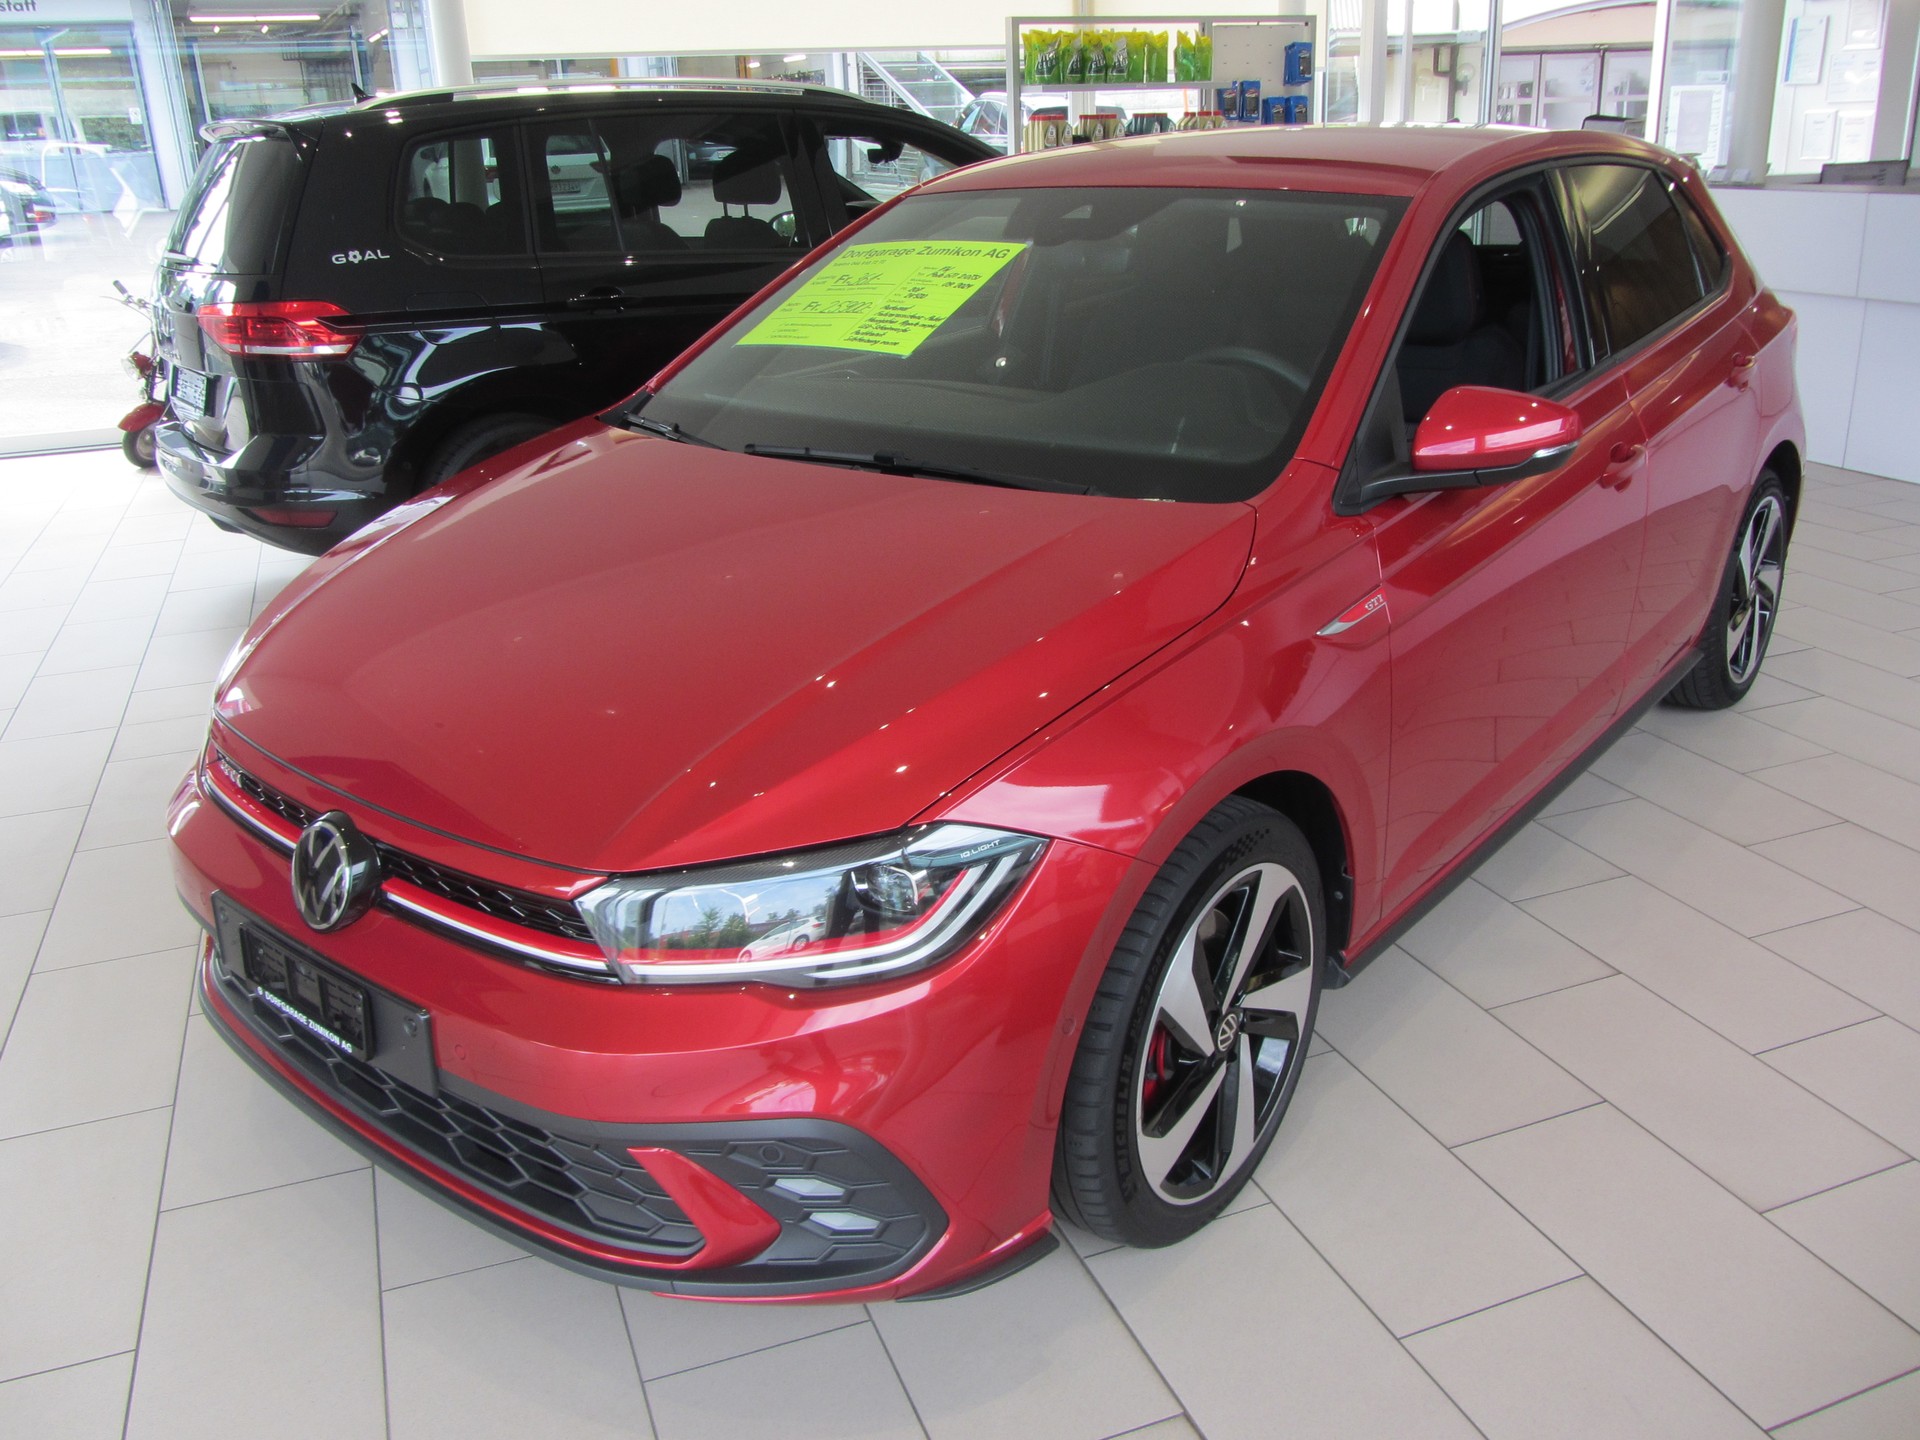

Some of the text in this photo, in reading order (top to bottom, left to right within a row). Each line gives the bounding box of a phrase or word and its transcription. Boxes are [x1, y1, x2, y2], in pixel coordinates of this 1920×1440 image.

[843, 245, 1011, 260] Dorfgarage Zumikon AG
[1364, 593, 1384, 611] GTI
[960, 839, 1001, 859] IQ.LIGHT
[264, 990, 354, 1055] DORFGARAGE ZUMIKON AG
[1115, 1055, 1132, 1180] MICHELIN
